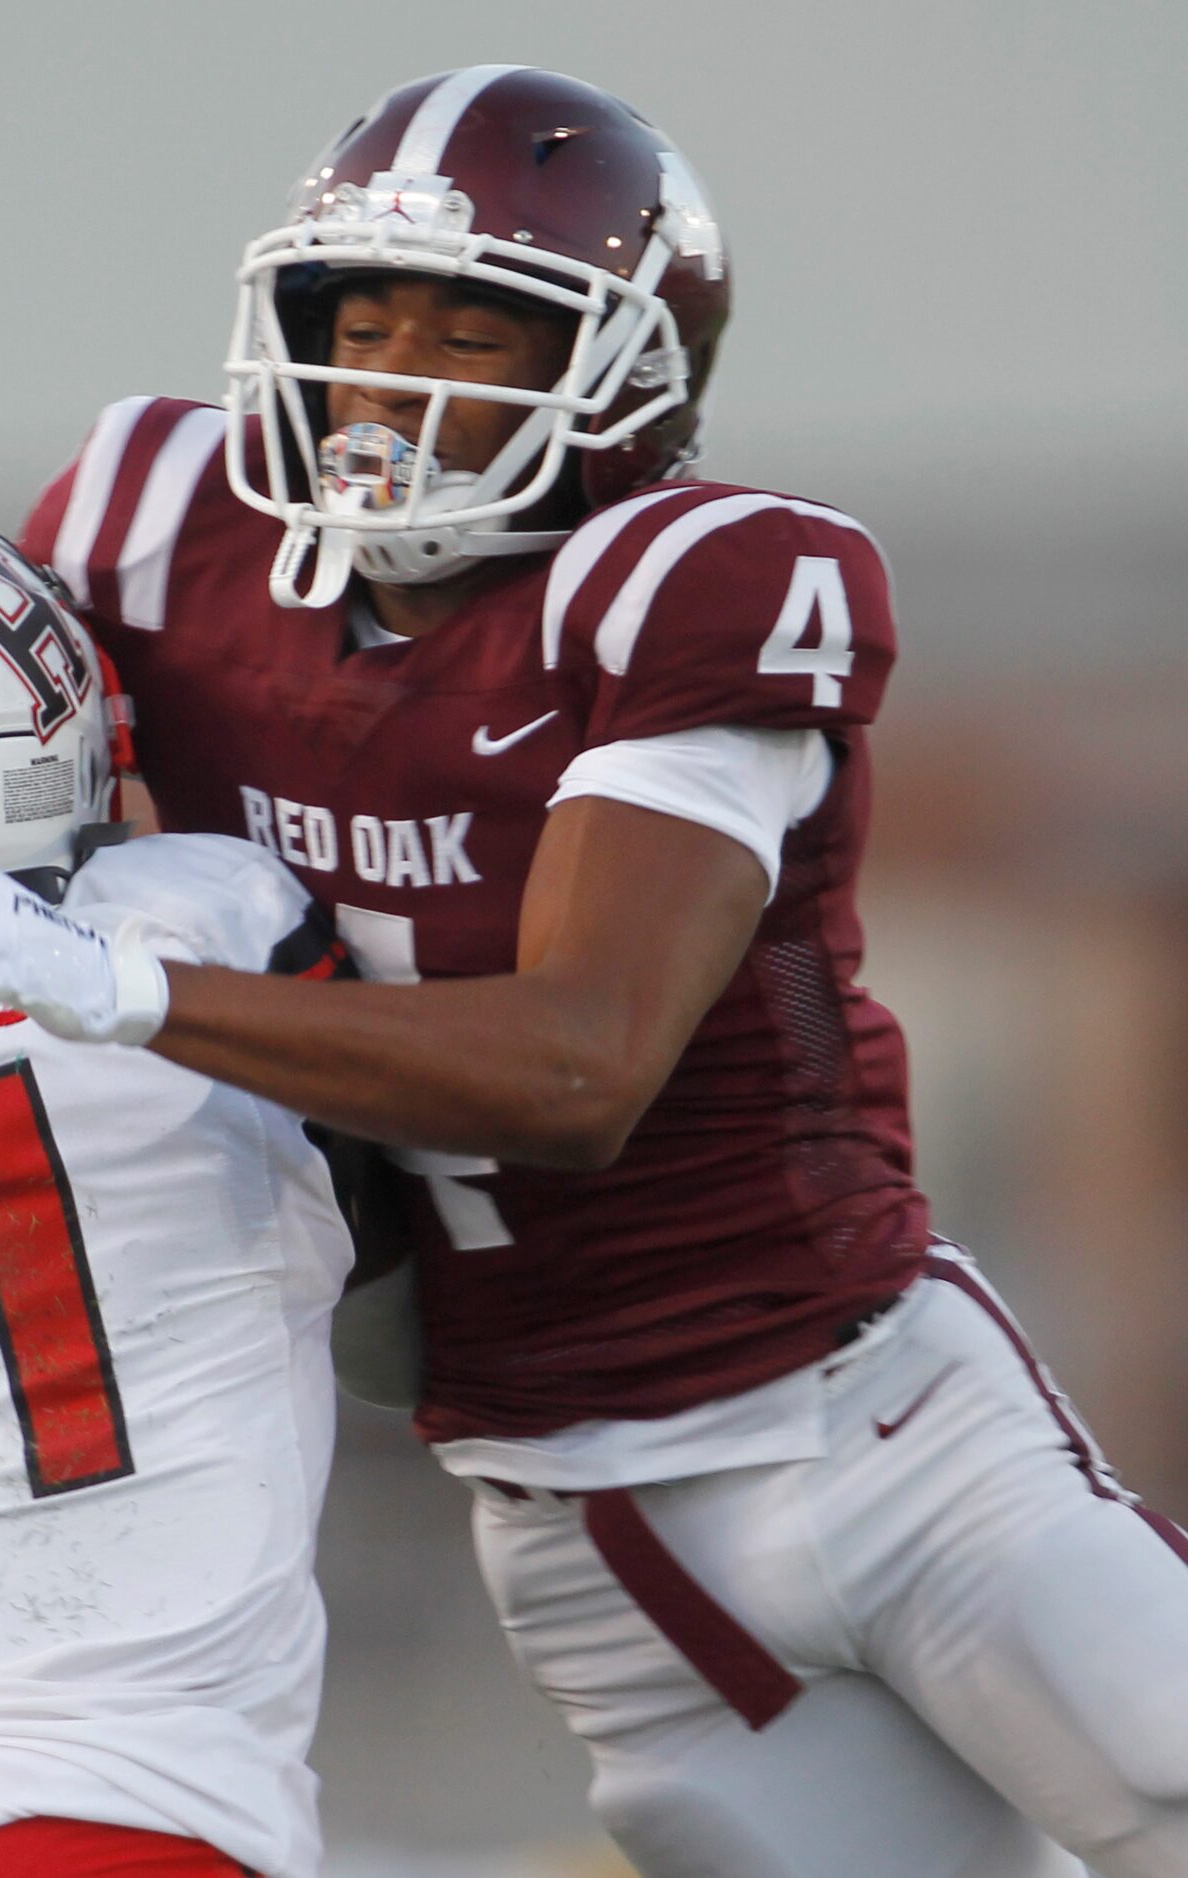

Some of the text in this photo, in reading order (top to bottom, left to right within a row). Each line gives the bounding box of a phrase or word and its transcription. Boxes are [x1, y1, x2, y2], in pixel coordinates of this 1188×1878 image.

[756, 555, 856, 708] 4
[238, 784, 483, 888] RED OAK
